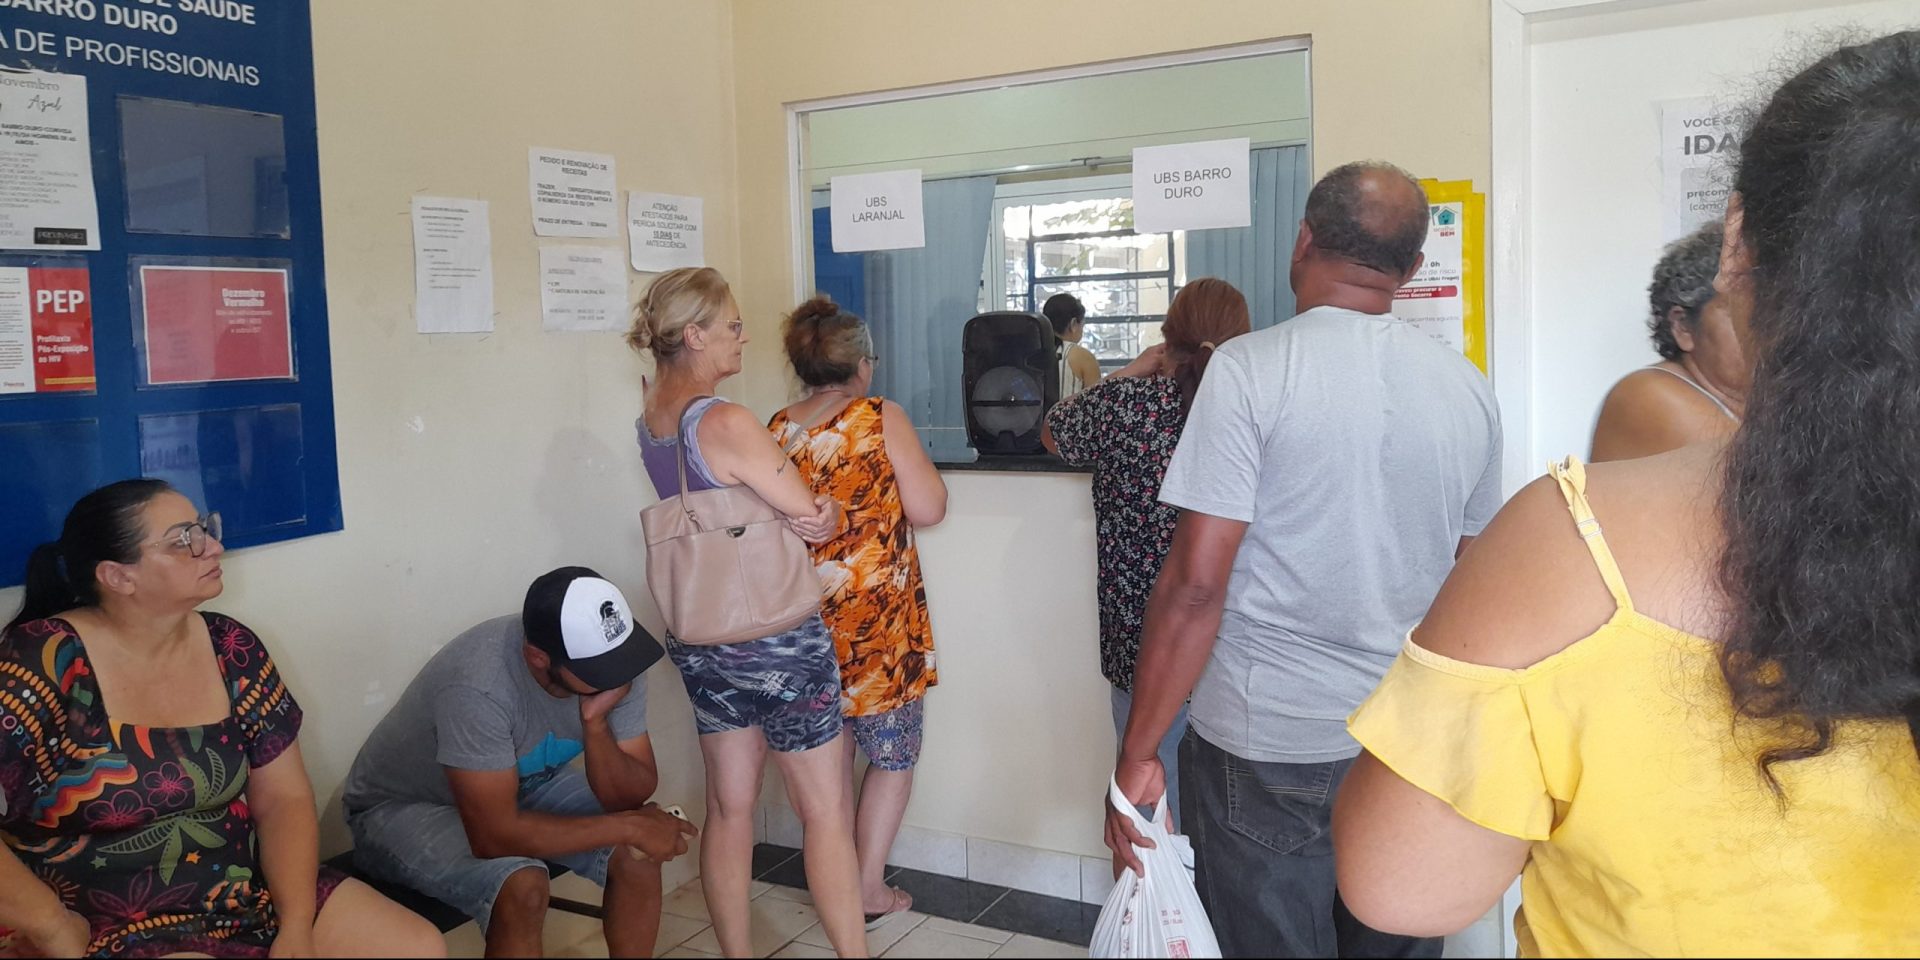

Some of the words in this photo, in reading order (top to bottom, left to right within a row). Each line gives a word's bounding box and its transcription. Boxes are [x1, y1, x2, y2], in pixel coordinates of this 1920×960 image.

[104, 4, 178, 35] DURO
[15, 28, 57, 56] DE
[66, 36, 260, 86] PROFISSIONAIS
[0, 78, 60, 91] ovembro
[1684, 133, 1742, 155] IDA
[540, 156, 560, 165] PEDIDO
[567, 160, 599, 170] RENOVAÇÃO
[562, 167, 587, 176] RECEITAS
[1153, 171, 1181, 184] UBS
[1184, 167, 1232, 182] BARRO
[1164, 185, 1203, 199] DURO
[652, 202, 678, 212] ATENÇÃO
[865, 196, 888, 208] UBS
[641, 211, 673, 220] ATESTADOS
[852, 209, 905, 223] LARANJAL
[656, 221, 683, 229] SOLICITAR
[685, 223, 697, 231] COM
[660, 230, 672, 240] DIAS
[222, 288, 265, 298] Dezembro
[37, 289, 85, 313] PEP
[223, 298, 265, 307] Vermelho
[37, 335, 71, 343] Profilaxia
[48, 355, 62, 363] HIV
